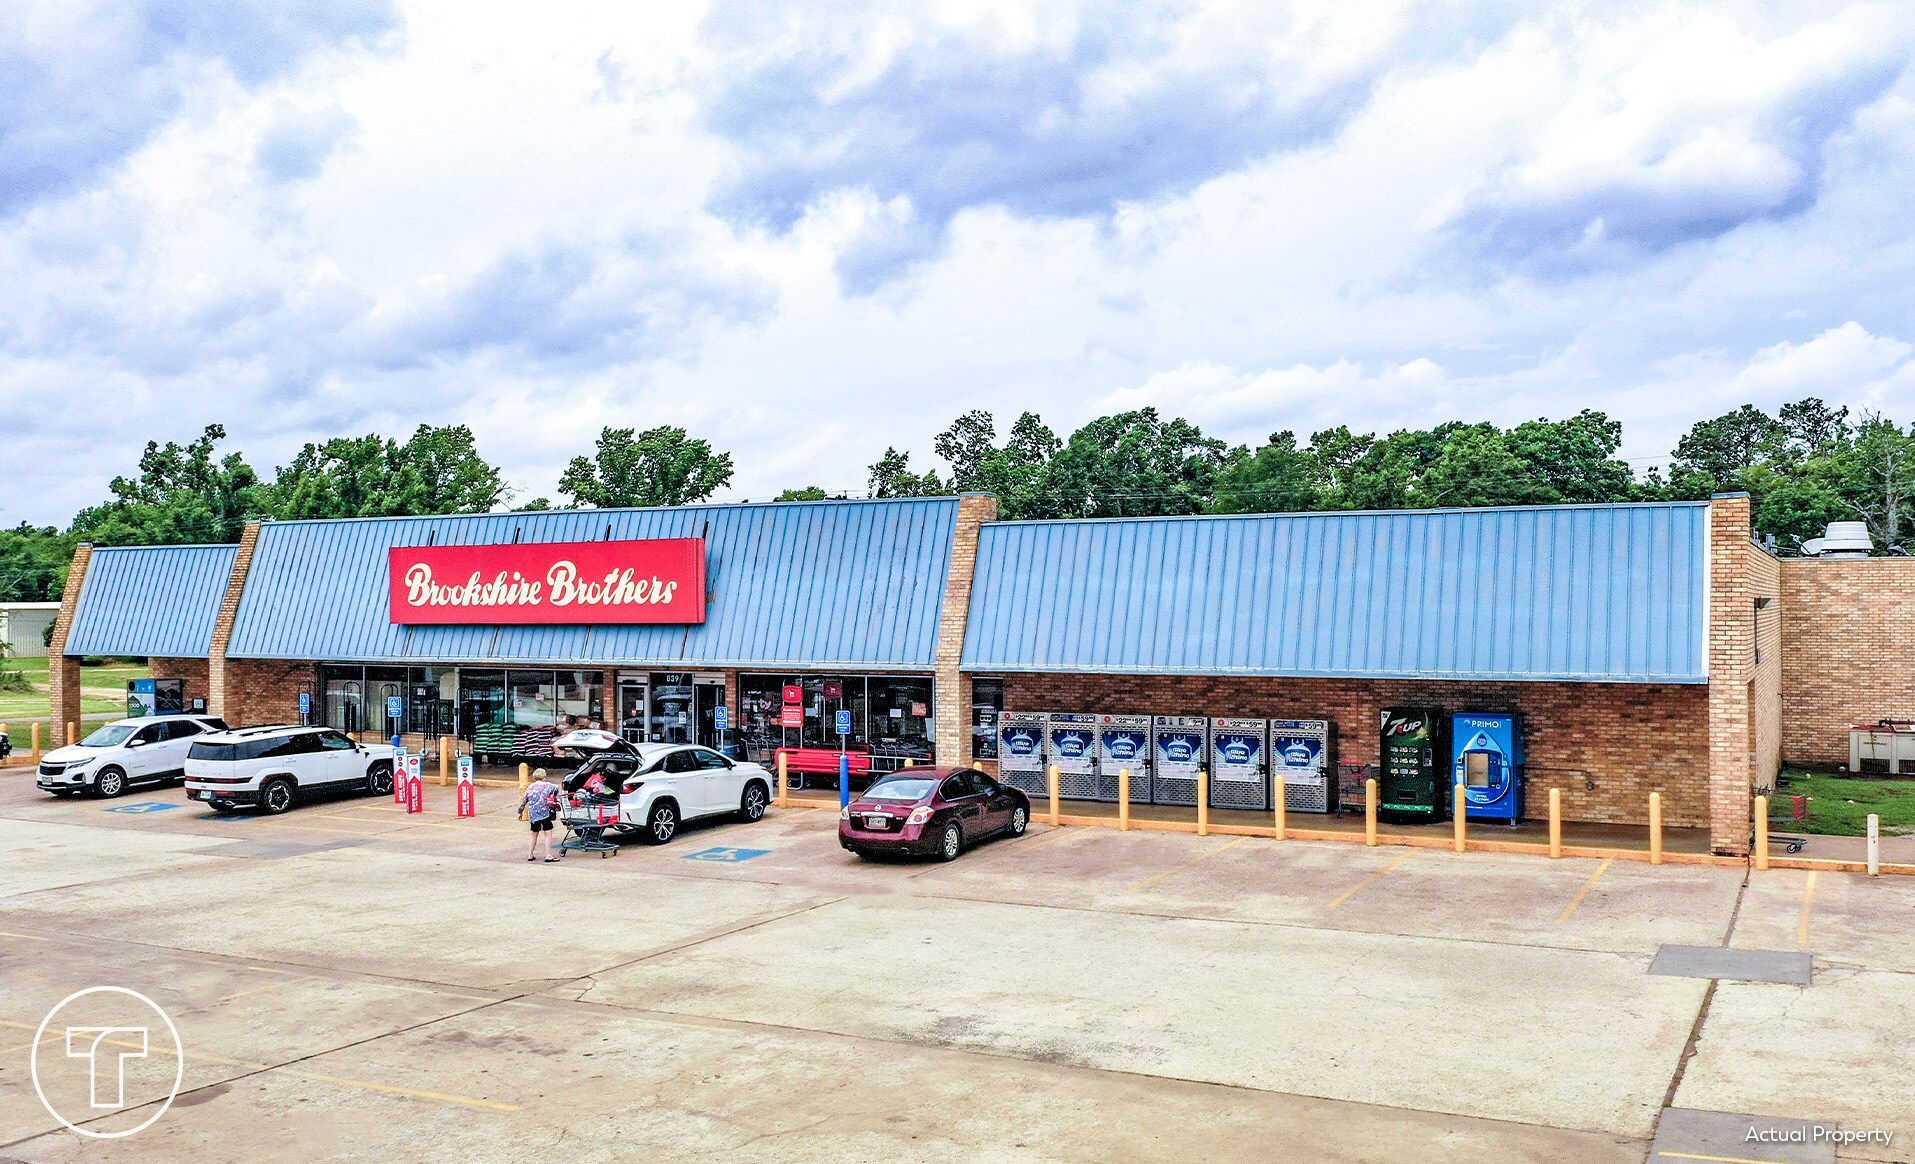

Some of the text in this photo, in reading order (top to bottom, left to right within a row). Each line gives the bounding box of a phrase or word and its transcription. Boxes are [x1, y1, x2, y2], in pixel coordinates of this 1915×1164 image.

[405, 560, 678, 607] Brookshire Brothers
[1471, 720, 1500, 729] PRIMO
